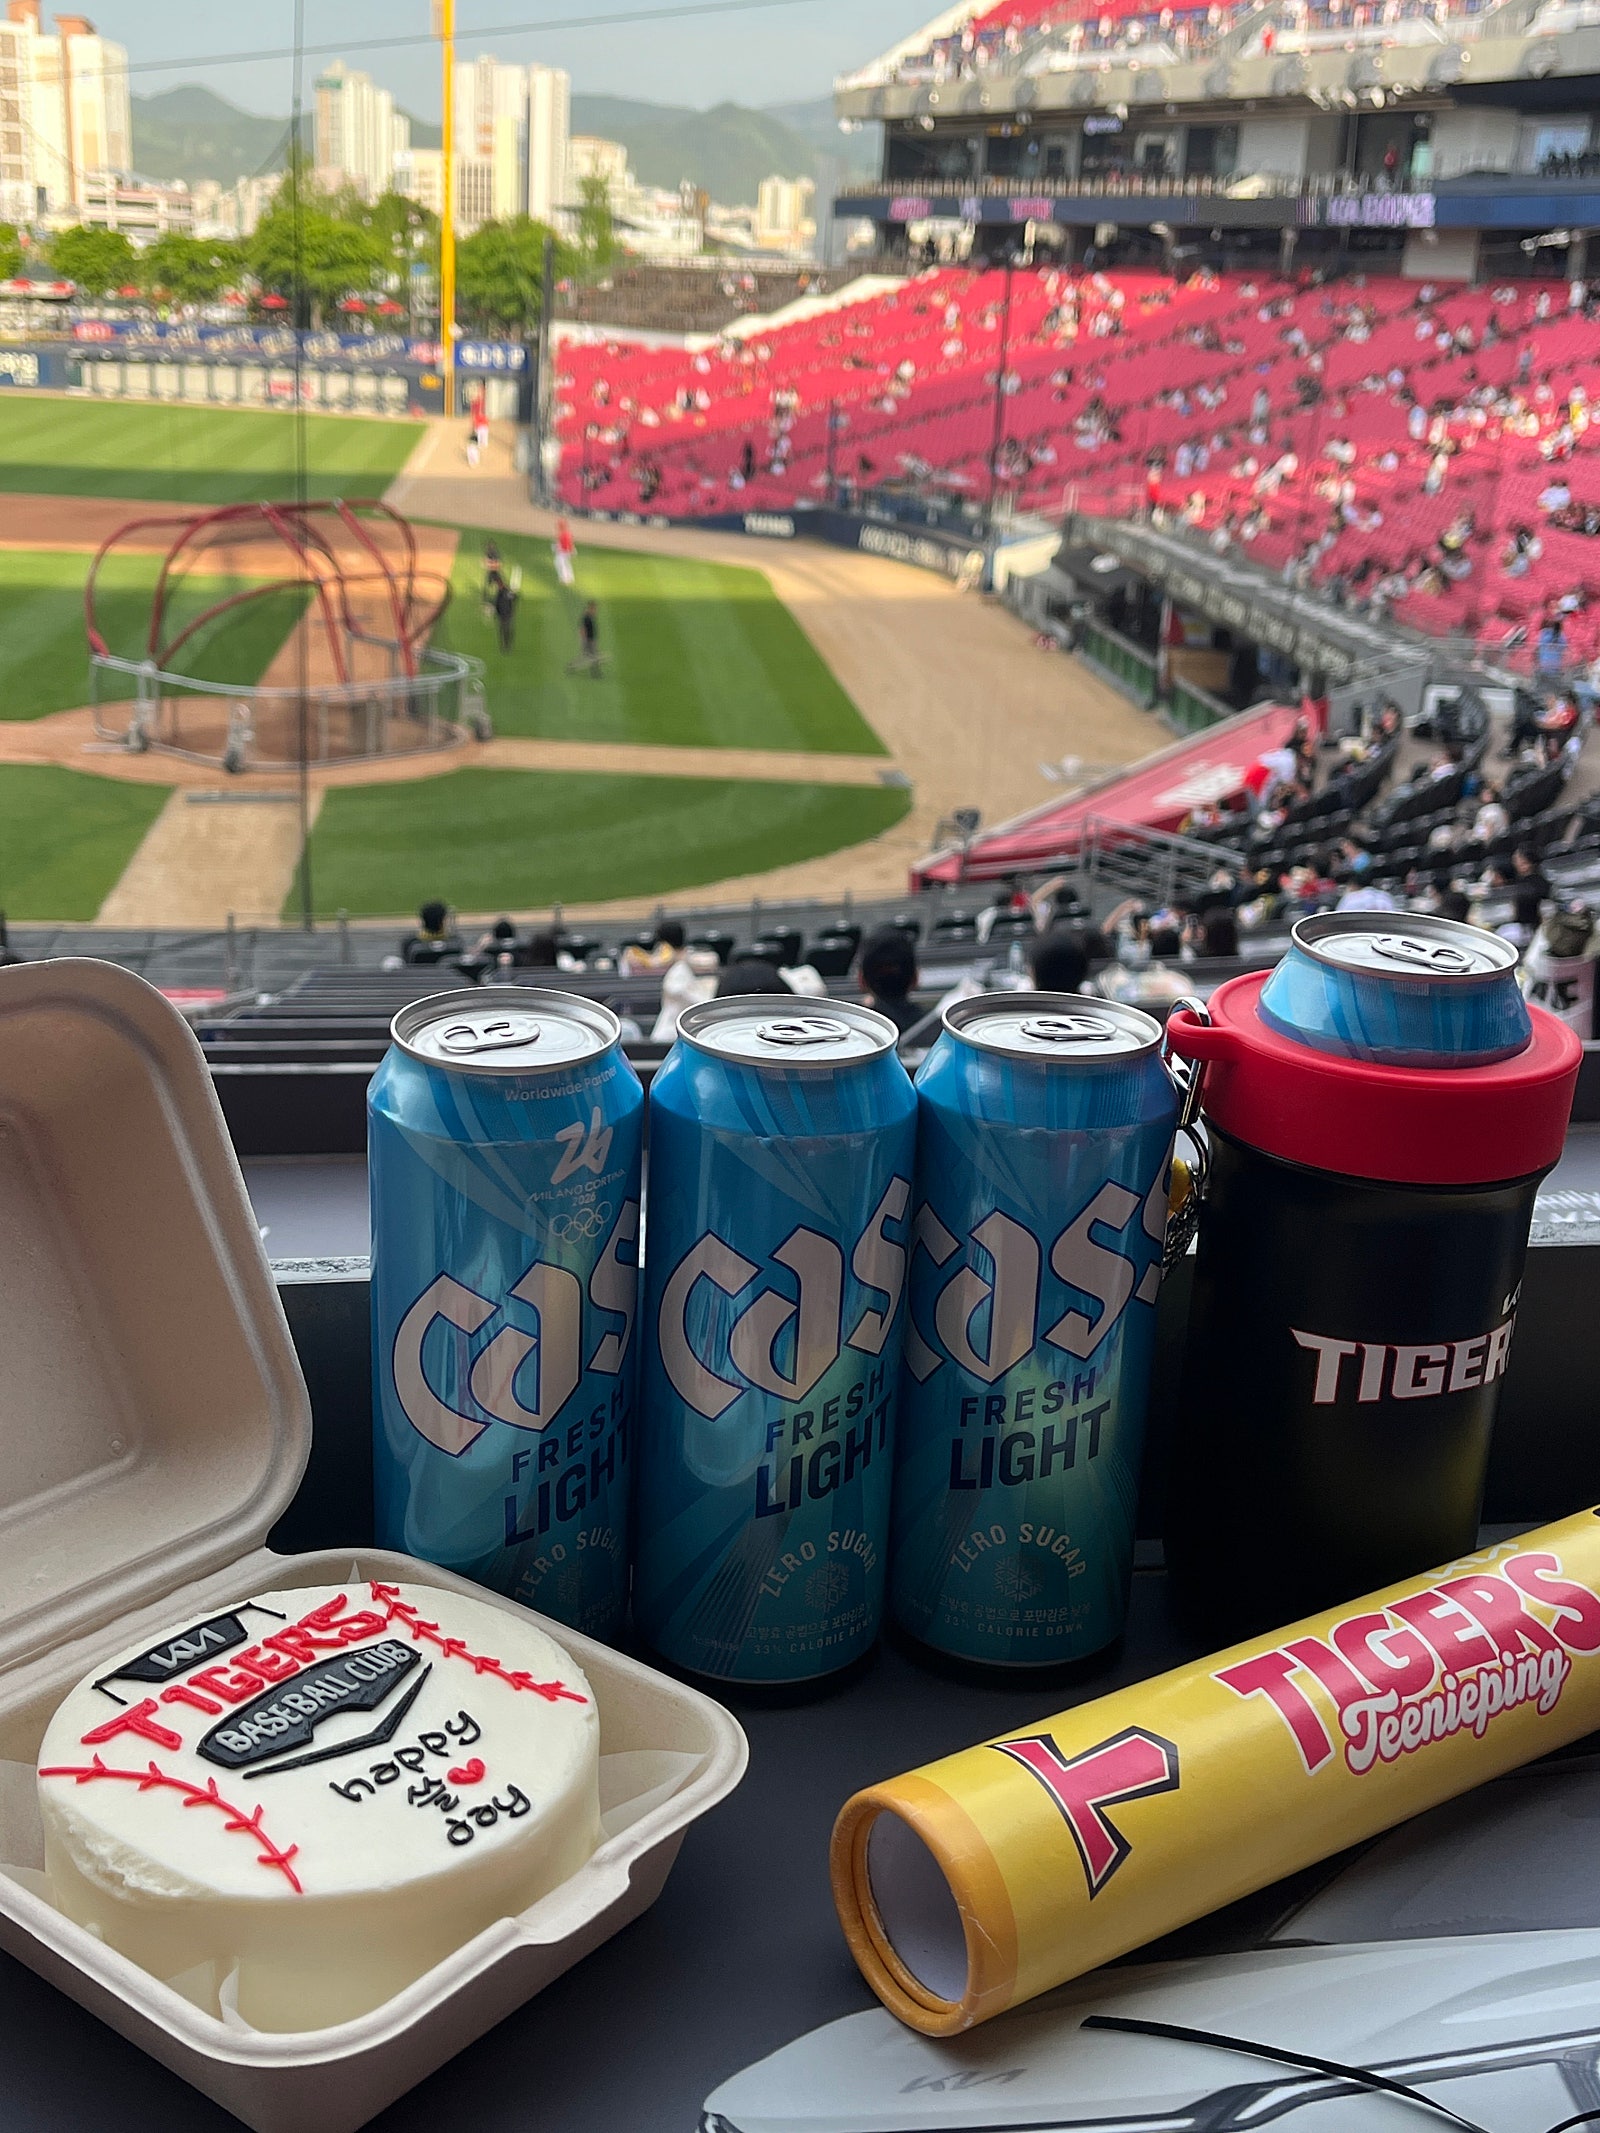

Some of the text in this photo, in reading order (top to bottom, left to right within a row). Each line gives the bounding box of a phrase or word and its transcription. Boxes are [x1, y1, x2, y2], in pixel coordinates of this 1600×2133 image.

[504, 1065, 617, 1102] Worldwide Partner
[528, 1168, 626, 1203] MILANO CORTINA
[572, 1192, 597, 1206] 2026
[959, 1366, 1096, 1428] FRESH
[1289, 1312, 1517, 1405] TIGER
[511, 1378, 625, 1484] FRESH
[765, 1361, 884, 1454] FRESH
[948, 1399, 1111, 1493] LIGHT
[503, 1407, 631, 1548] LIGHT
[753, 1392, 893, 1520] LIGHT
[514, 1527, 622, 1600] ZERO SUGAR
[758, 1529, 878, 1598] ZERO SUGAR
[950, 1522, 1087, 1579] ZERO SUGAR
[80, 1593, 387, 1752] TIGERS
[790, 1631, 845, 1654] CALORIE
[977, 1622, 1040, 1638] CALORIE
[1209, 1551, 1600, 1777] TIGERS
[215, 1642, 411, 1755] BASEBALL CLUB
[1337, 1648, 1572, 1777] Teenieping
[329, 1710, 482, 1803] happy
[445, 1783, 531, 1846] day
